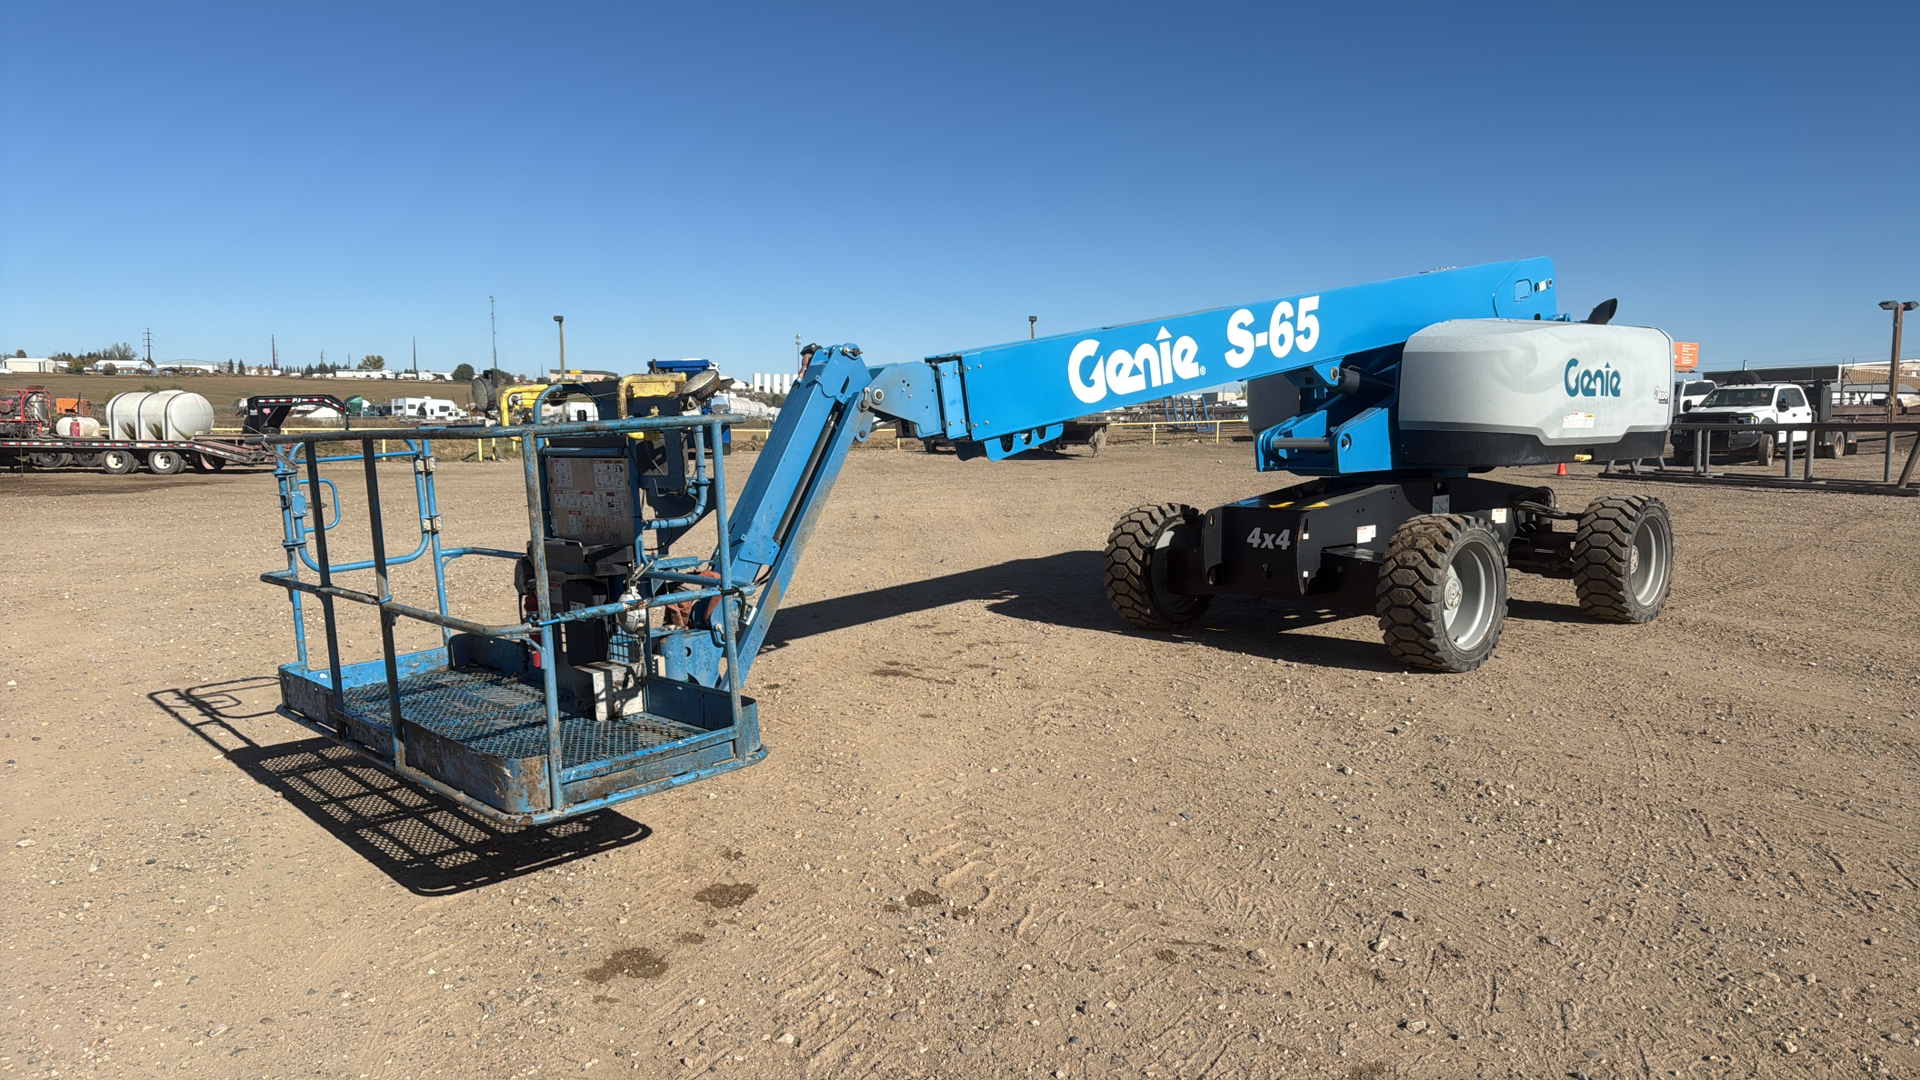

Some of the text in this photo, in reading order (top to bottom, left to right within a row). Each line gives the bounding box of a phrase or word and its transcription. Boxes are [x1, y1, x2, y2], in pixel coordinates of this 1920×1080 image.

[1068, 295, 1319, 403] Genie S-65
[1564, 358, 1621, 397] Genie
[1246, 527, 1291, 550] 4x4
